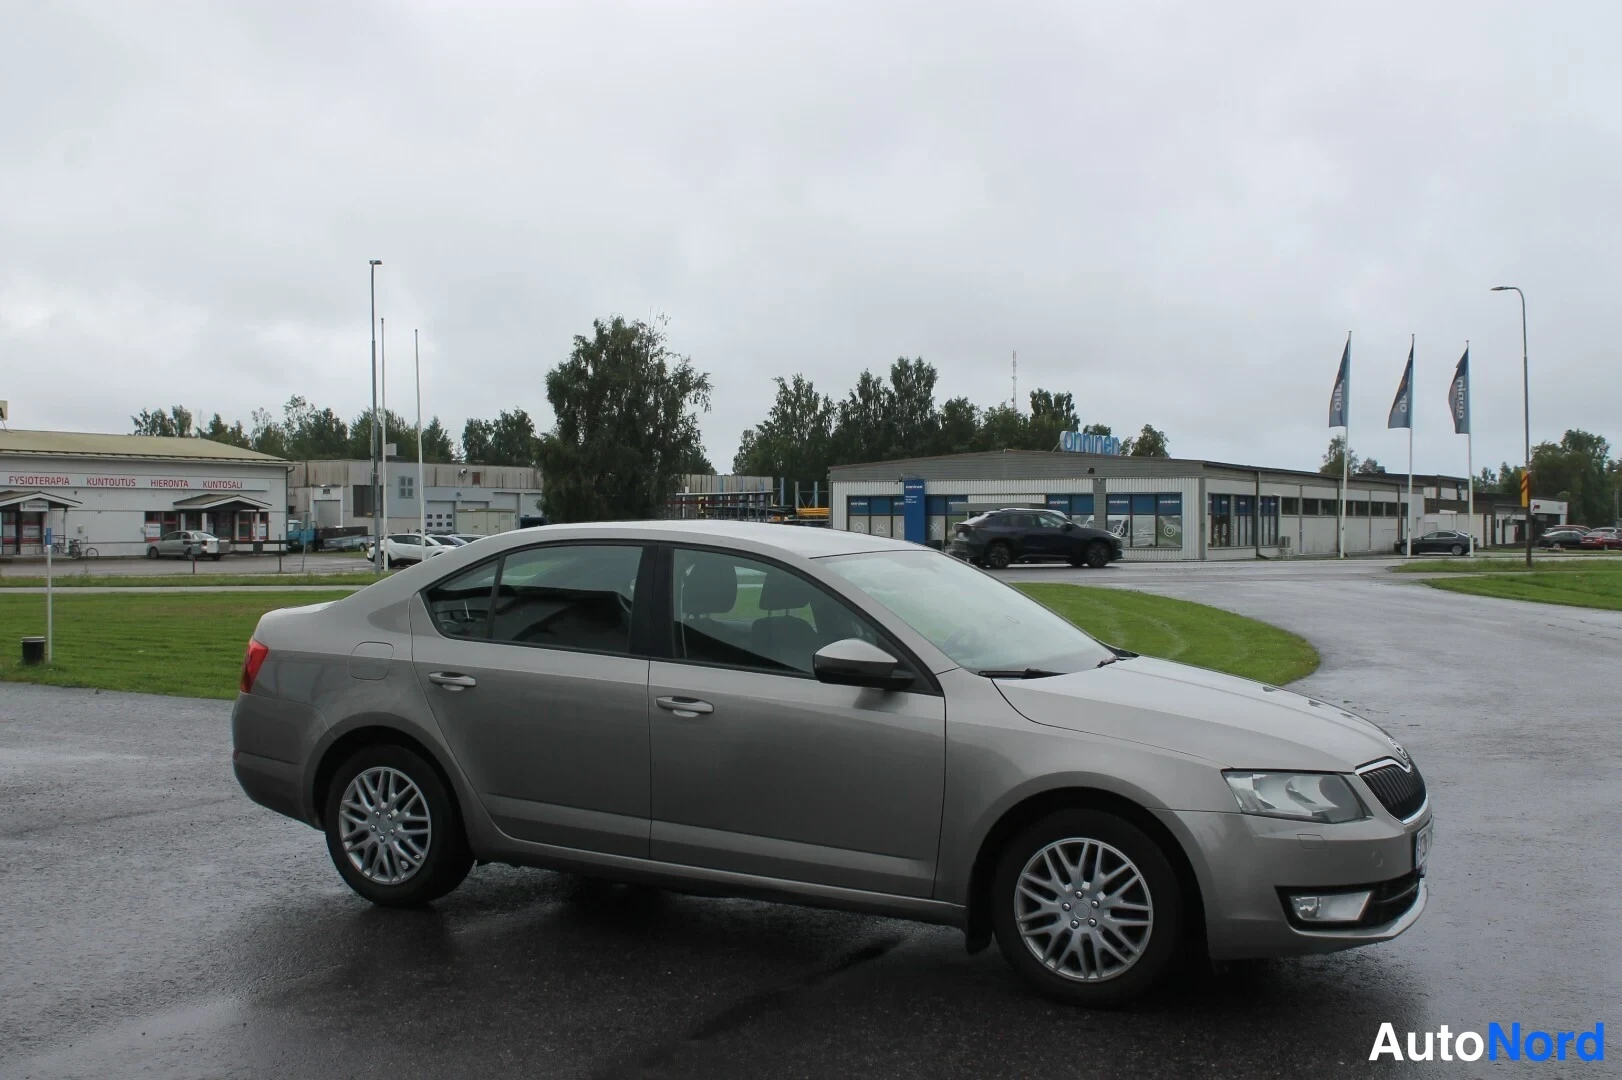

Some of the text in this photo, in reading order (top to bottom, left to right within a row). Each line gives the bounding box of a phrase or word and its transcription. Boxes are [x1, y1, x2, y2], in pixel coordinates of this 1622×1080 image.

[1062, 430, 1120, 456] onninen
[9, 475, 243, 489] FYSIOTERAPIA KUNTOUTUS HIERONTA KUNTOSALI
